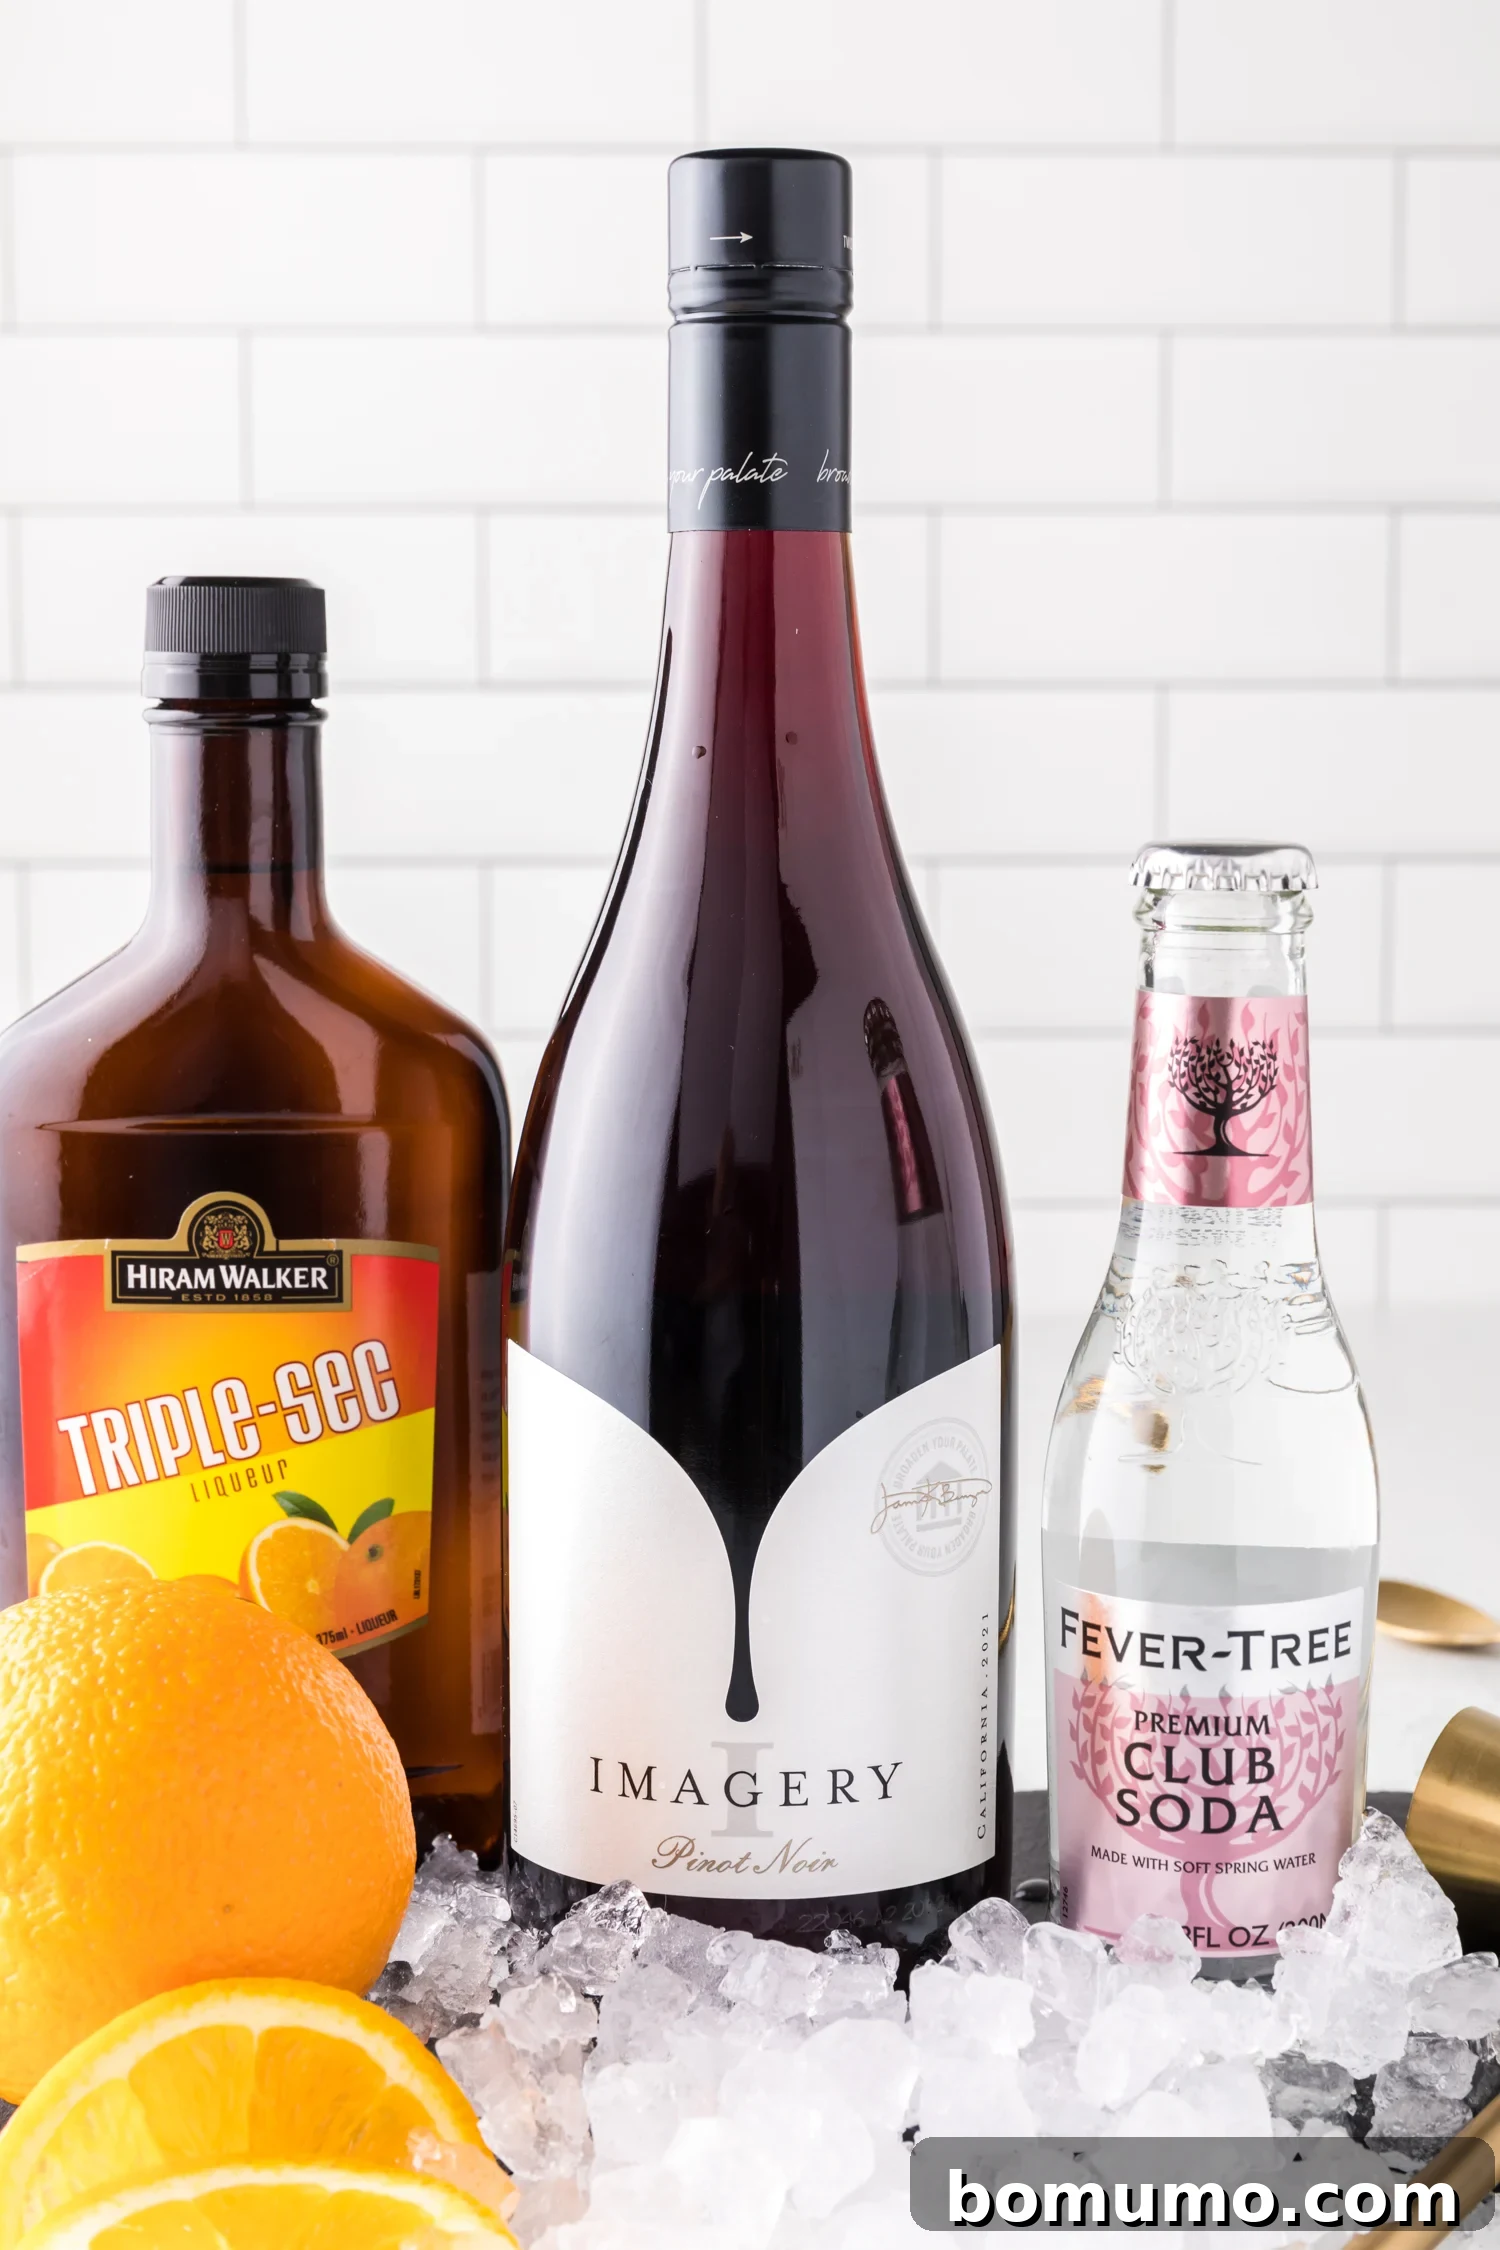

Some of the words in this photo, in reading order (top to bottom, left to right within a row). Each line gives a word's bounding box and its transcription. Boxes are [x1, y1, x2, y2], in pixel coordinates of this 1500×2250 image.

[698, 452, 788, 510] palate
[127, 1264, 216, 1291] HIRAM
[219, 1264, 329, 1290] WALKER
[181, 1293, 226, 1302] ESTD
[234, 1293, 273, 1302] 1858
[932, 1435, 956, 1450] YOUR
[955, 1441, 978, 1474] PALATE
[356, 1608, 398, 1635] LIQUEUR
[1060, 1606, 1352, 1672] FEVER-TREE
[1134, 1710, 1271, 1737] PREMIUM
[590, 1756, 903, 1808] IMAGERY
[1123, 1742, 1276, 1786] CLUB
[1115, 1788, 1284, 1834] SODA
[651, 1835, 752, 1874] Pinot
[752, 1837, 839, 1875] Noir
[1091, 1845, 1128, 1866] MADE
[1132, 1855, 1169, 1872] WITH
[1173, 1861, 1211, 1874] SOFT
[1215, 1860, 1269, 1875] SPRING
[1273, 1852, 1317, 1871] WATER
[1228, 1924, 1270, 1948] OZ
